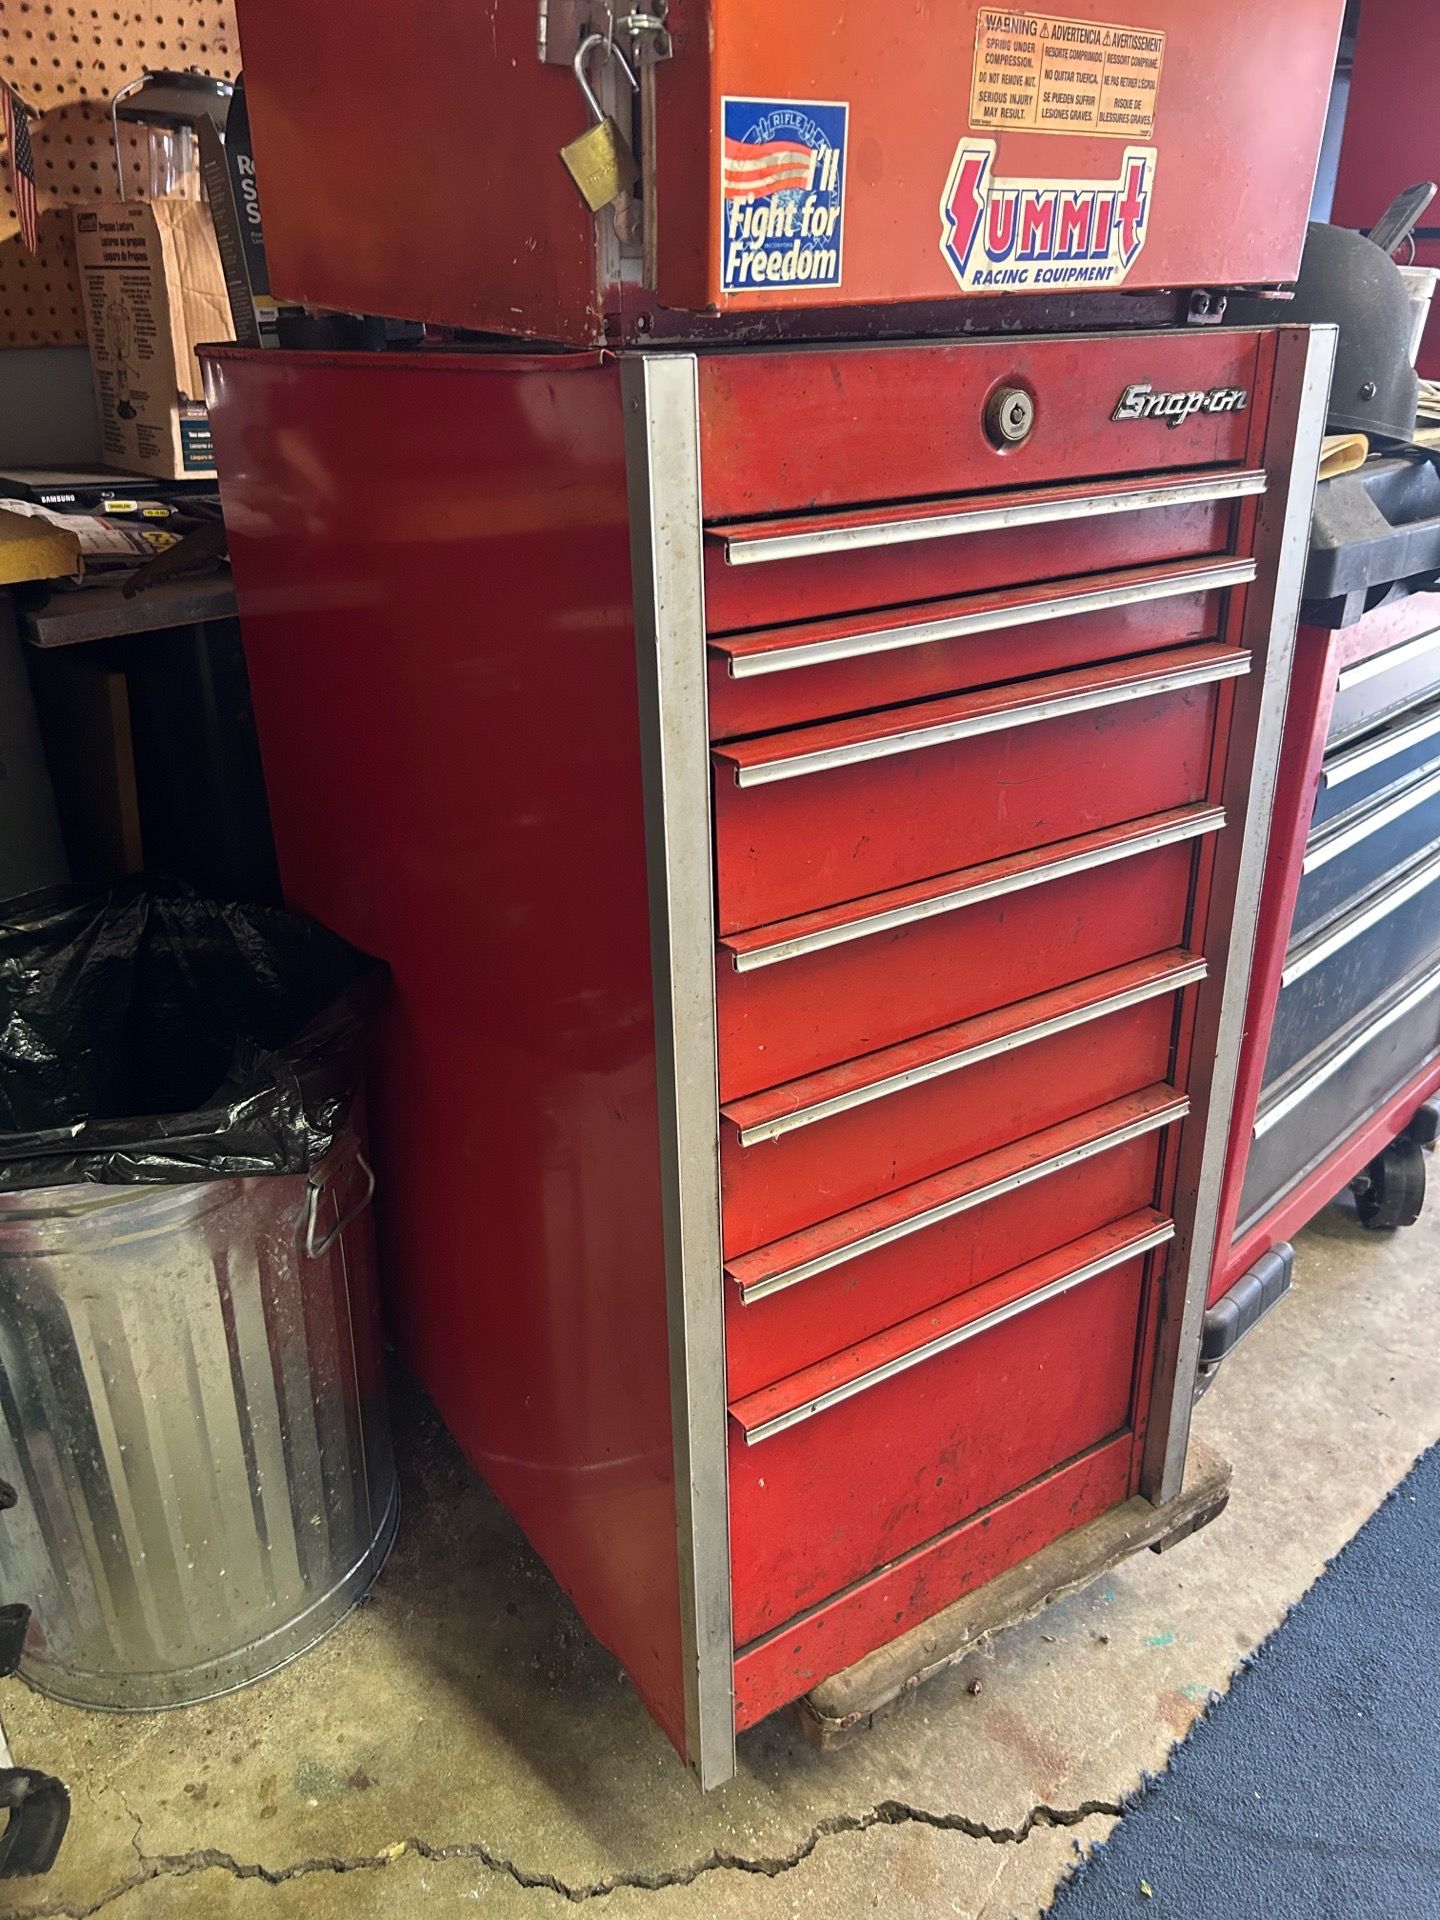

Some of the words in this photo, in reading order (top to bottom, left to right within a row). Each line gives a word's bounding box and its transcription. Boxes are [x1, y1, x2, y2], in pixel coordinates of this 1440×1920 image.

[986, 14, 1038, 36] WARNING
[1051, 25, 1101, 46] ADVERTENCIA
[1112, 33, 1162, 52] AVERTISSEMENT
[986, 38, 1011, 51] SPRING
[1014, 41, 1036, 53] UNDER
[1045, 46, 1069, 59] RESORTE
[985, 53, 1034, 68] COMPRESSION.
[1107, 53, 1130, 65] RESSORT
[979, 72, 987, 83] DO
[989, 72, 999, 84] NOT
[1001, 74, 1023, 86] REMOVE
[1044, 69, 1053, 80] NO
[1054, 70, 1075, 82] QUITAR
[1076, 72, 1098, 84] TUERCA.
[1104, 75, 1111, 86] NE
[1111, 75, 1120, 87] PAS
[1120, 77, 1138, 88] RETIRER
[979, 91, 1007, 104] SERIOUS
[1010, 94, 1033, 106] INJURY
[1043, 92, 1051, 102] SE
[1052, 92, 1074, 104] PUEDEN
[1075, 95, 1095, 106] SUFRIR
[1114, 98, 1134, 109] RISQUE
[1134, 99, 1142, 110] DE
[773, 114, 802, 126] RIFLE
[984, 106, 998, 118] MAY
[1001, 107, 1026, 119] RESULT.
[1042, 108, 1069, 120] LESIONES
[1070, 110, 1093, 121] GRAVES.
[1099, 112, 1130, 124] BLESSURES
[806, 144, 840, 191] I'll
[242, 178, 257, 201] S
[246, 202, 261, 224] S
[729, 192, 798, 250] Fight
[801, 195, 840, 238] for
[726, 240, 836, 282] Freedom
[972, 269, 1028, 285] RACING
[1034, 266, 1113, 283] EQUIPMENT
[1110, 384, 1247, 429] Snap-on
[41, 494, 76, 503] SAMSUNG
